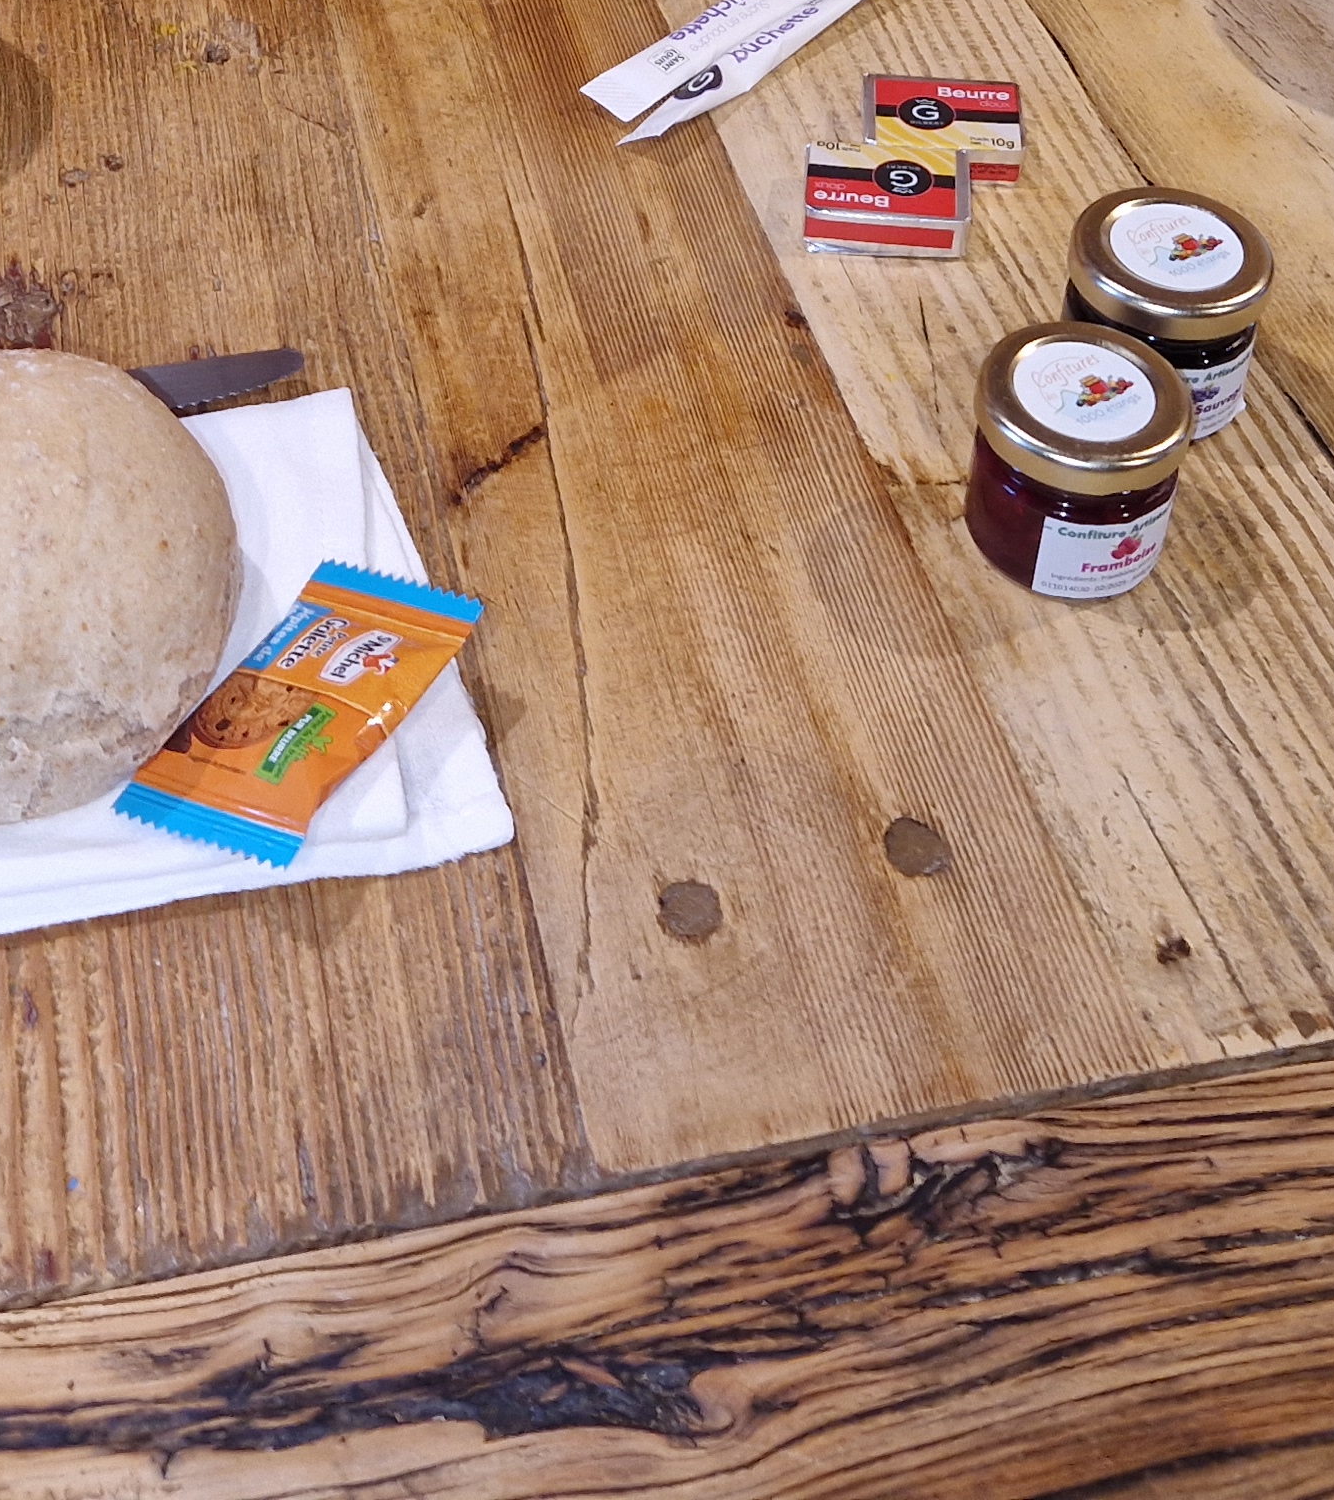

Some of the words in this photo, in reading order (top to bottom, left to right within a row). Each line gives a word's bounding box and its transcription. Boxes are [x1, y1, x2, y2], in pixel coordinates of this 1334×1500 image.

[654, 47, 680, 66] LOUIS
[661, 50, 685, 72] SAINT
[937, 86, 1010, 100] Beurre
[912, 105, 939, 120] G
[990, 138, 1014, 149] 10g
[814, 181, 846, 190] doux
[889, 170, 918, 187] G
[814, 190, 889, 208] Beurre
[1127, 216, 1191, 245] Confitures
[1168, 262, 1196, 276] 1000
[1031, 354, 1100, 388] Confitures
[1075, 410, 1105, 424] 1000
[1058, 526, 1127, 540] Confiture
[280, 618, 349, 668] Galette
[316, 632, 348, 657] Petite
[330, 639, 384, 679] Michel
